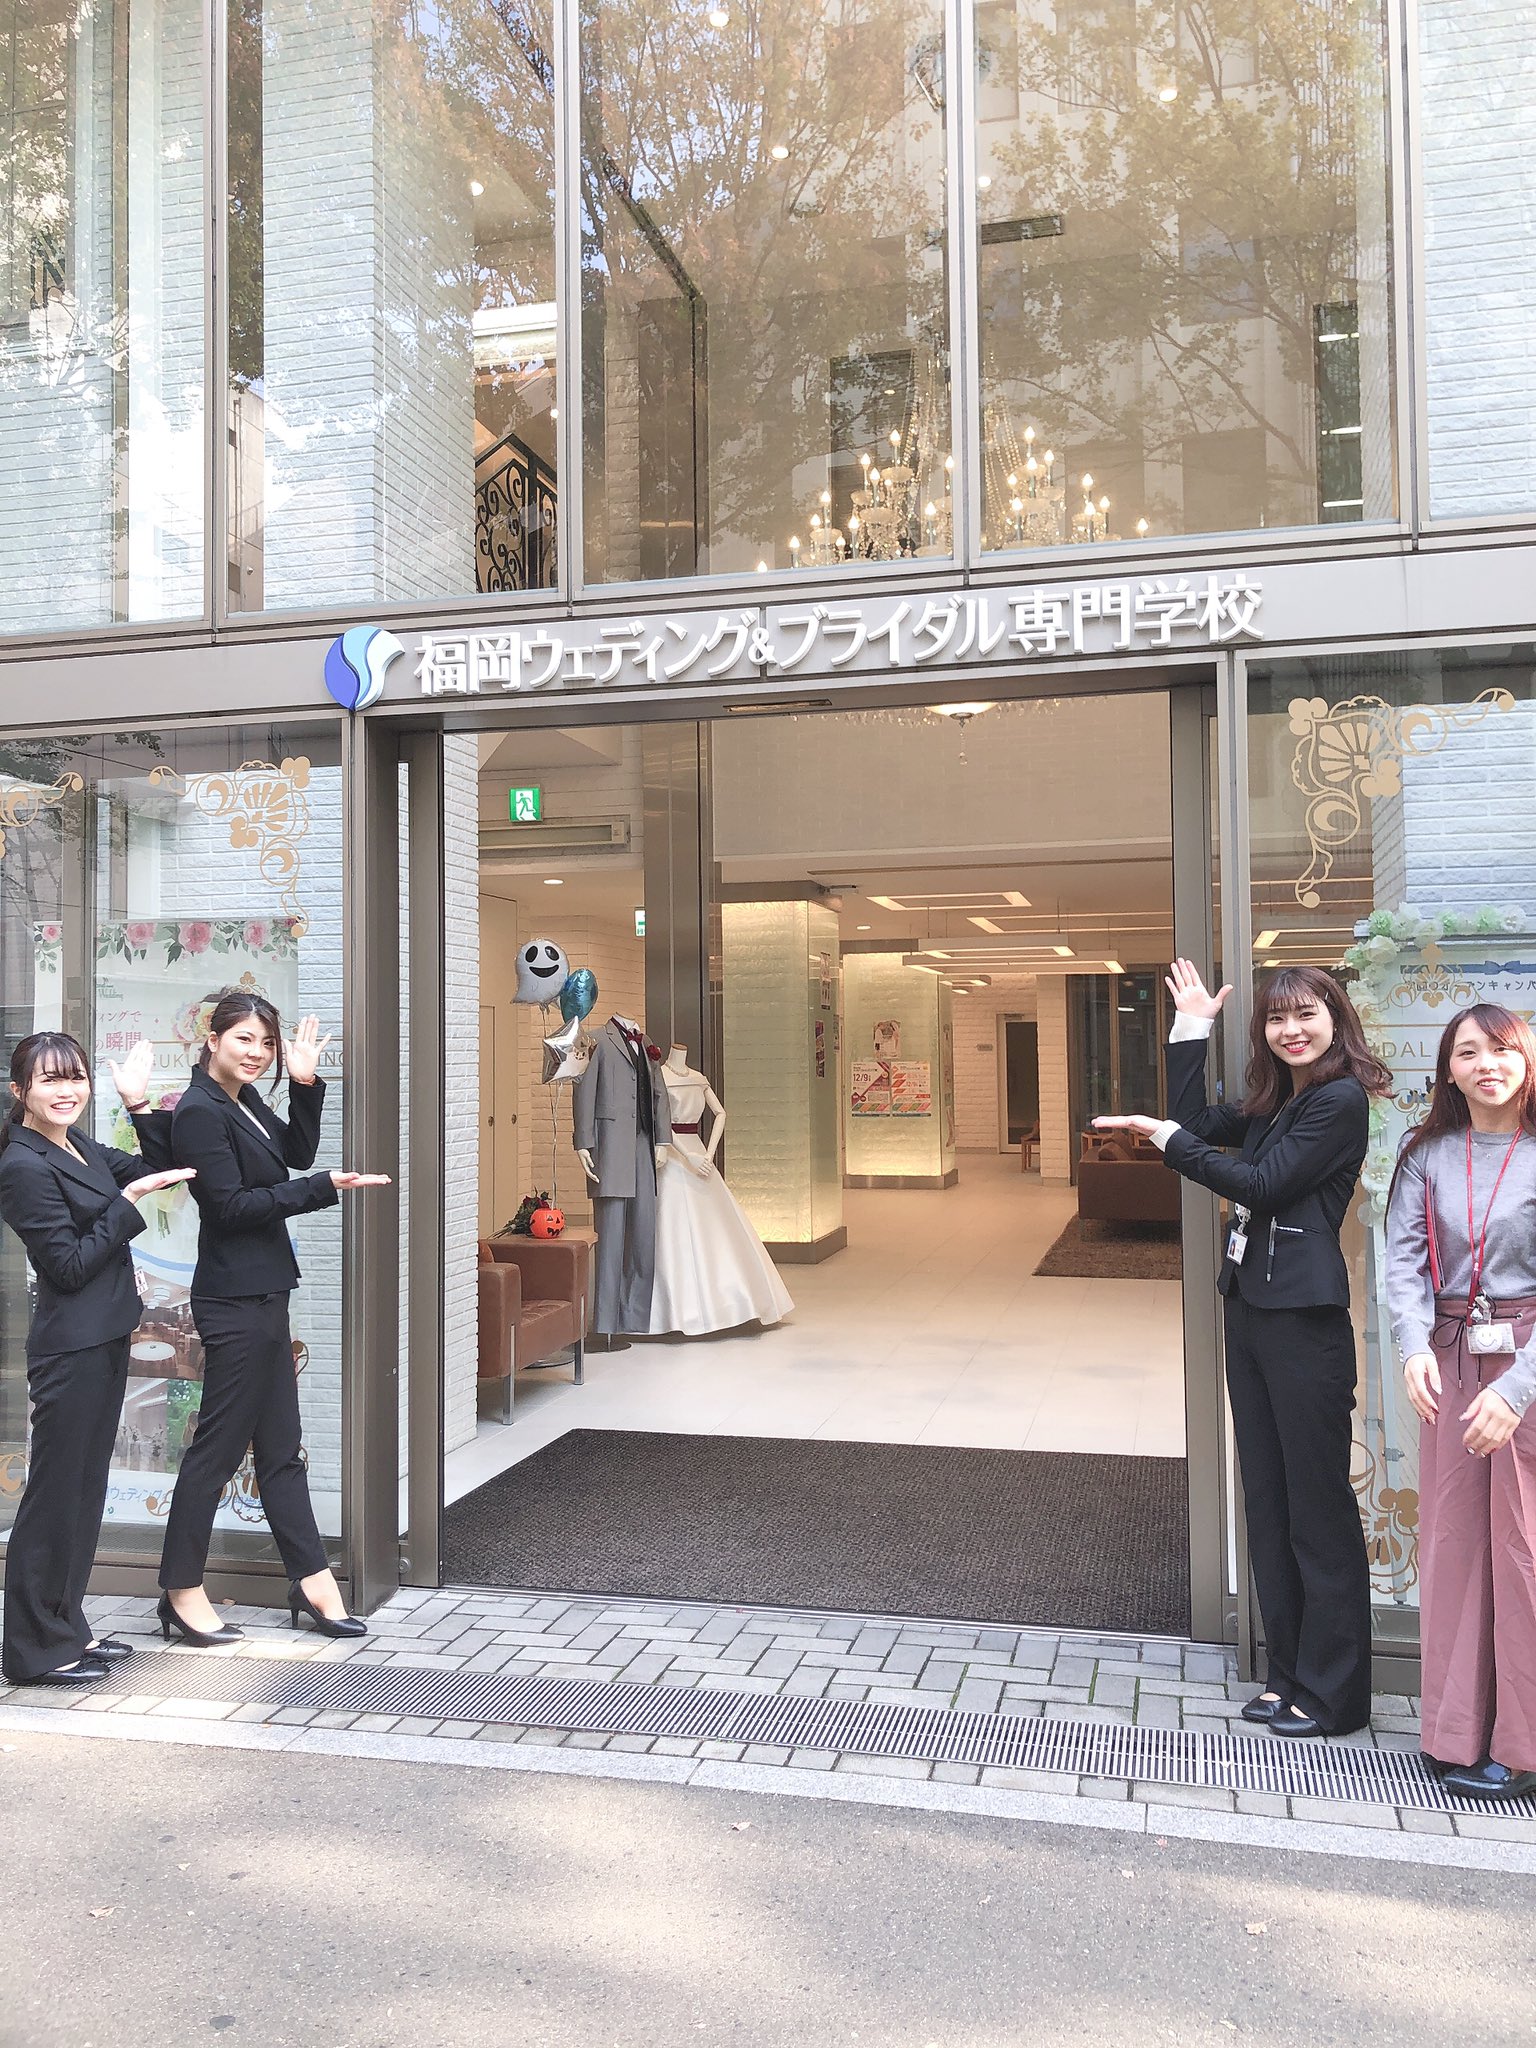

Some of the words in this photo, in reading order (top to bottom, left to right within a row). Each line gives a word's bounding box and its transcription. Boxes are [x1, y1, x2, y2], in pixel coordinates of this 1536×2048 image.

[414, 573, 1264, 696] 福岡ウェディング&ブライダル専門学校
